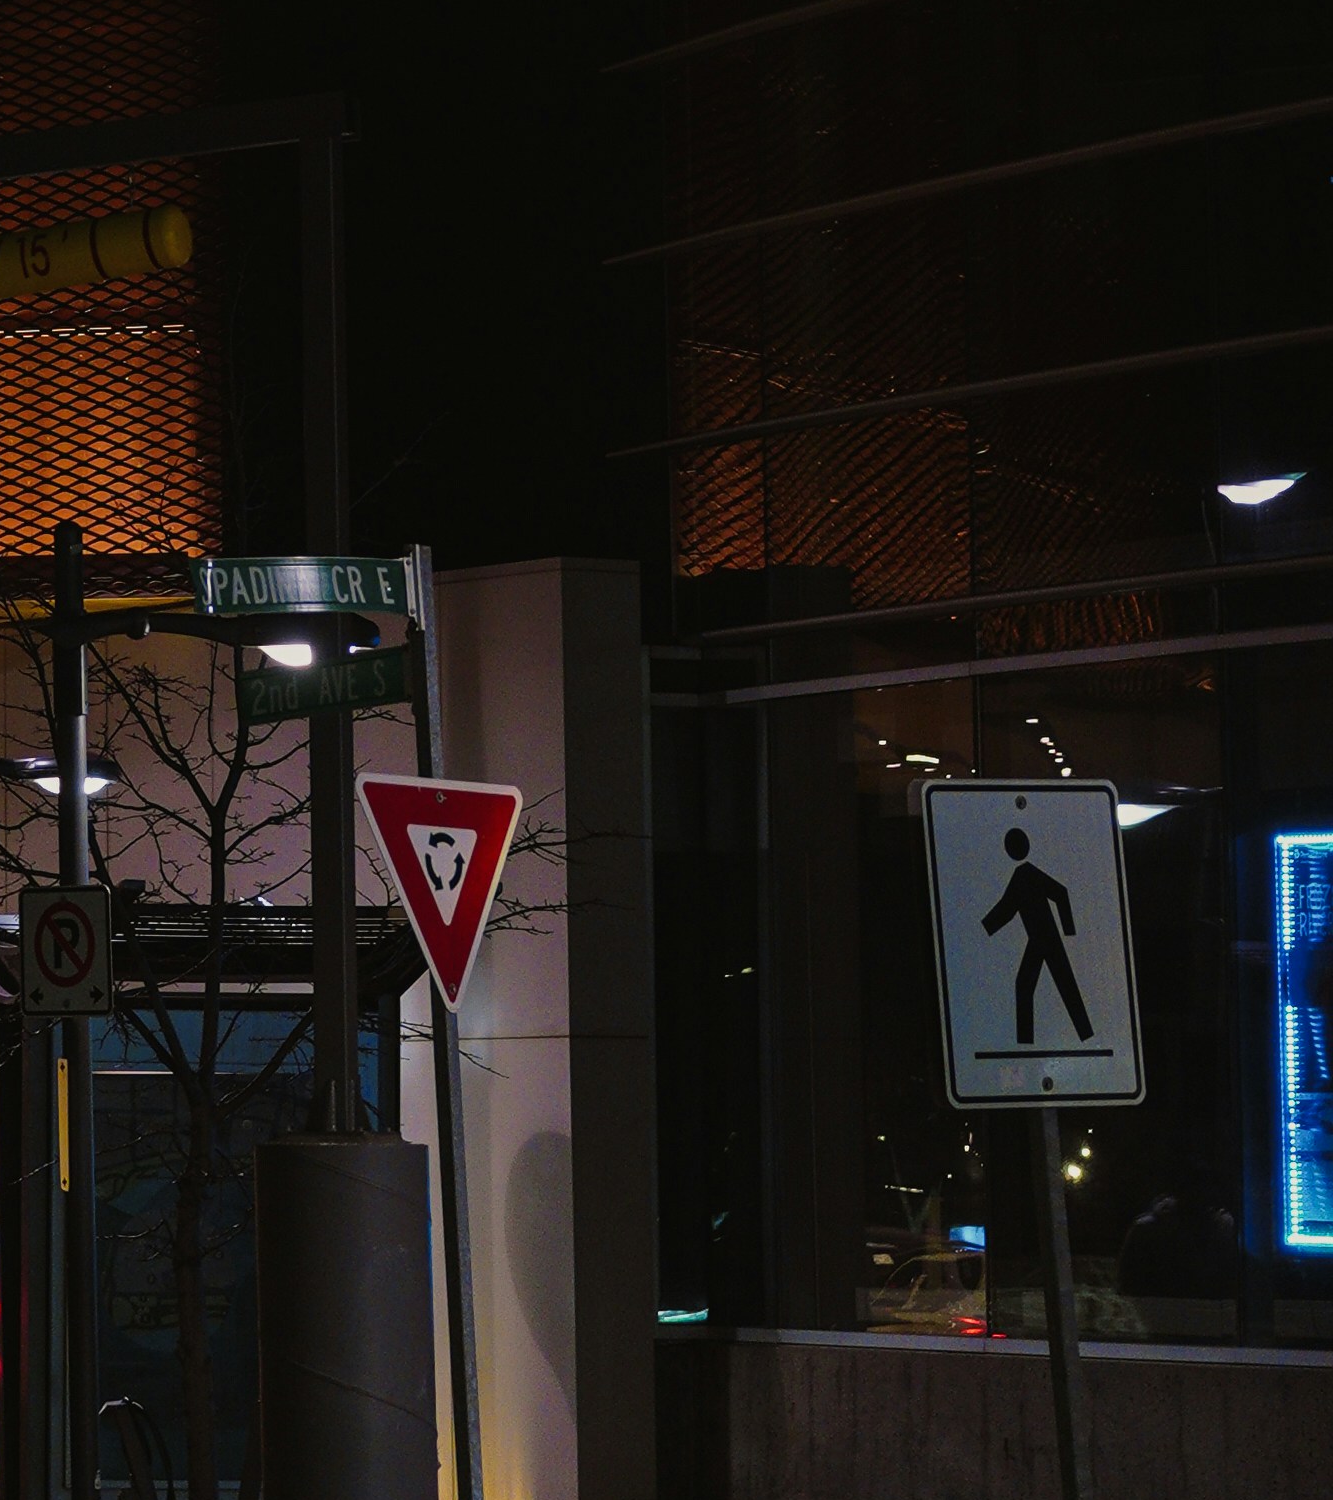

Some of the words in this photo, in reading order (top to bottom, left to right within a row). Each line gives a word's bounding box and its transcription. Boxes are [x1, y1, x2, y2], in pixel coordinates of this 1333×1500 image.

[331, 565, 367, 604] CR
[376, 567, 395, 604] E
[250, 673, 299, 715] 2nd
[319, 665, 358, 704] AVE
[372, 659, 386, 697] S
